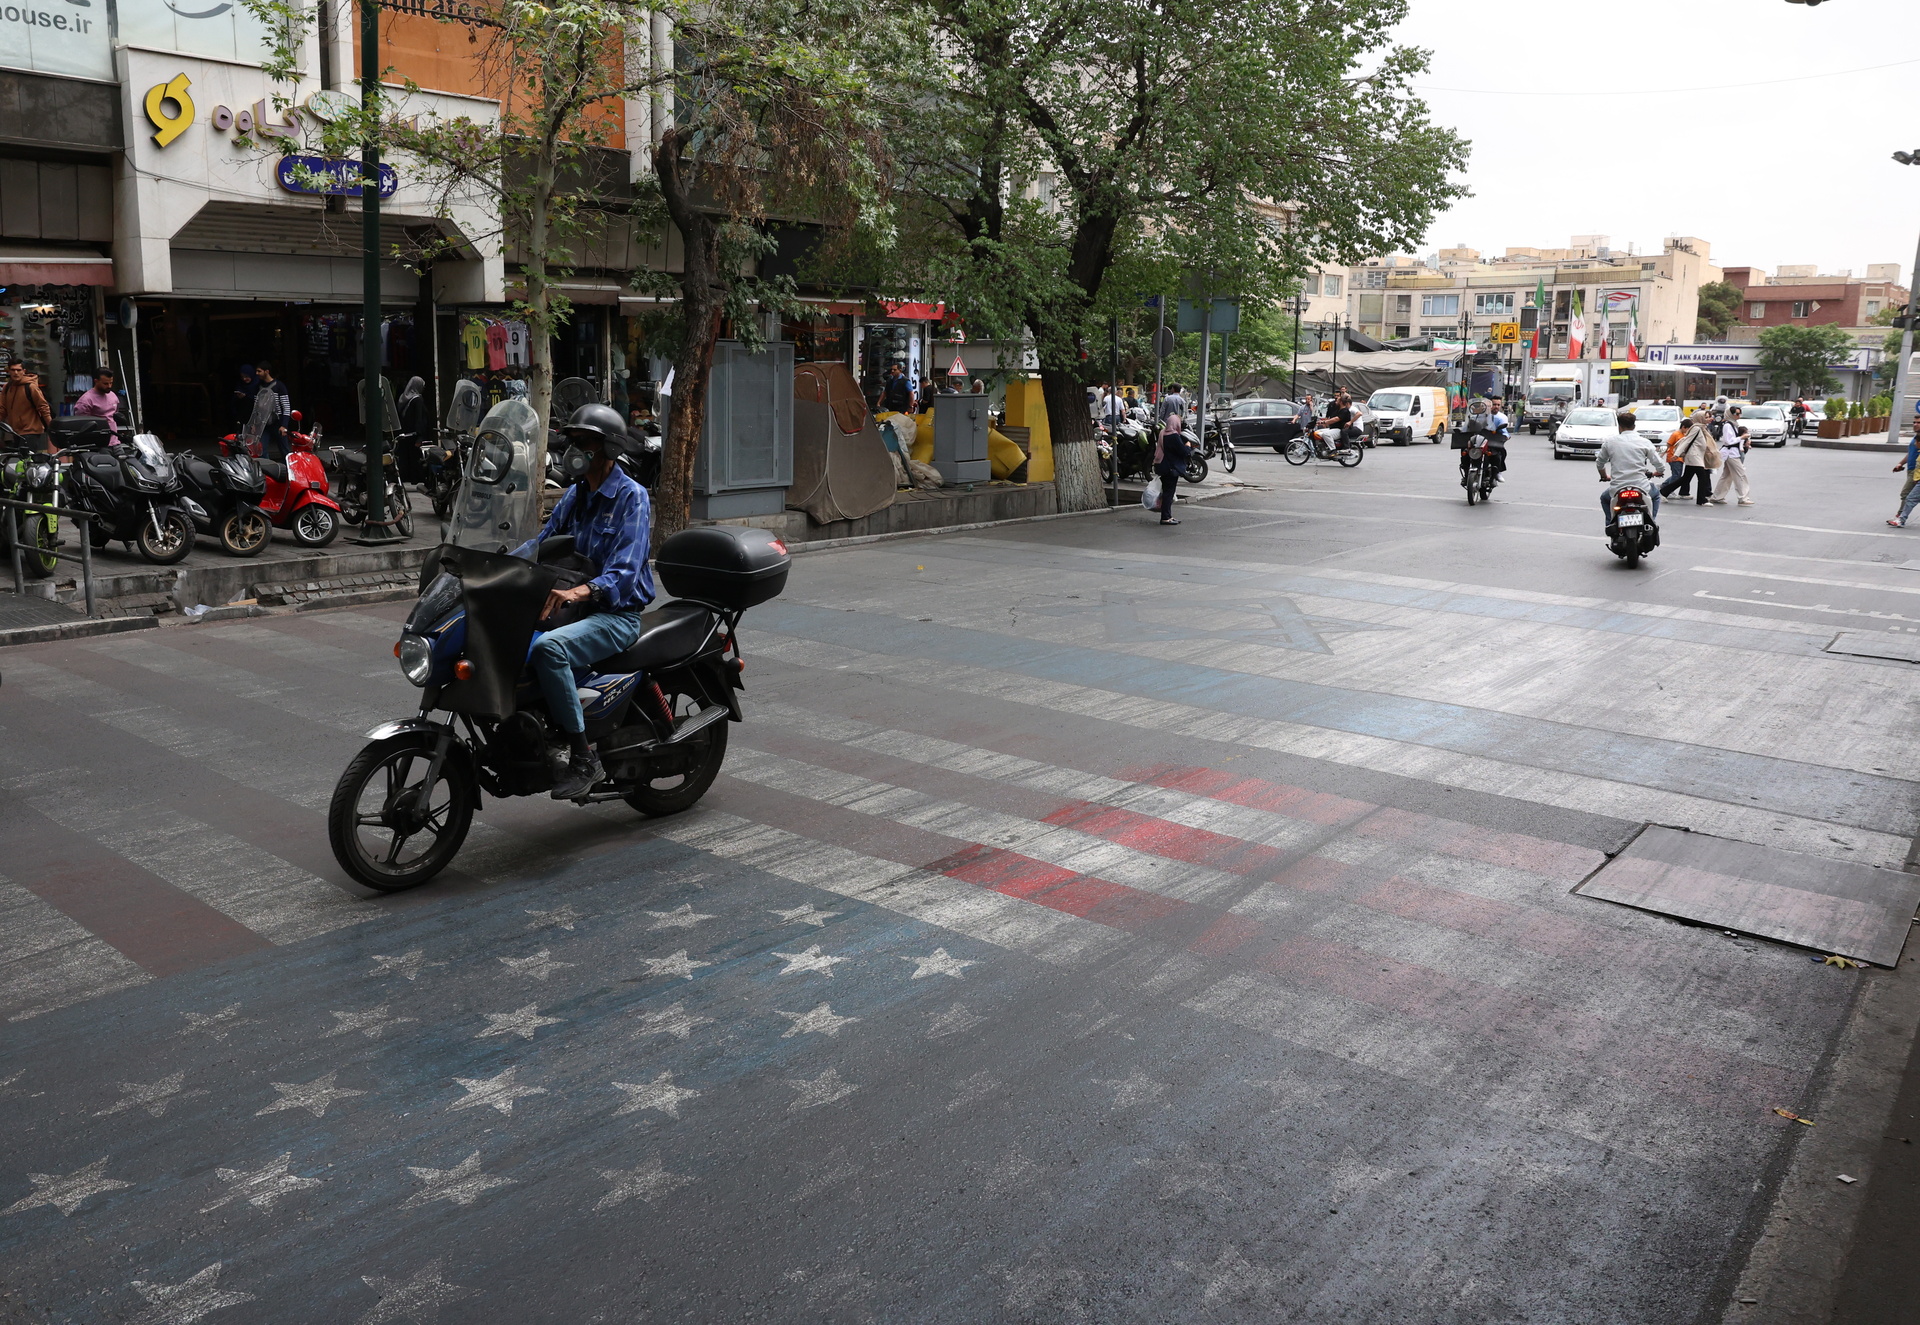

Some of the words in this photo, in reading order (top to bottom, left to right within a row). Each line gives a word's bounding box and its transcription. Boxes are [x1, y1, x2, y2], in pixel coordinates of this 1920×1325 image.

[62, 287, 88, 305] تولید
[472, 335, 480, 349] 10
[512, 331, 519, 346] 9
[1674, 353, 1692, 361] BANK
